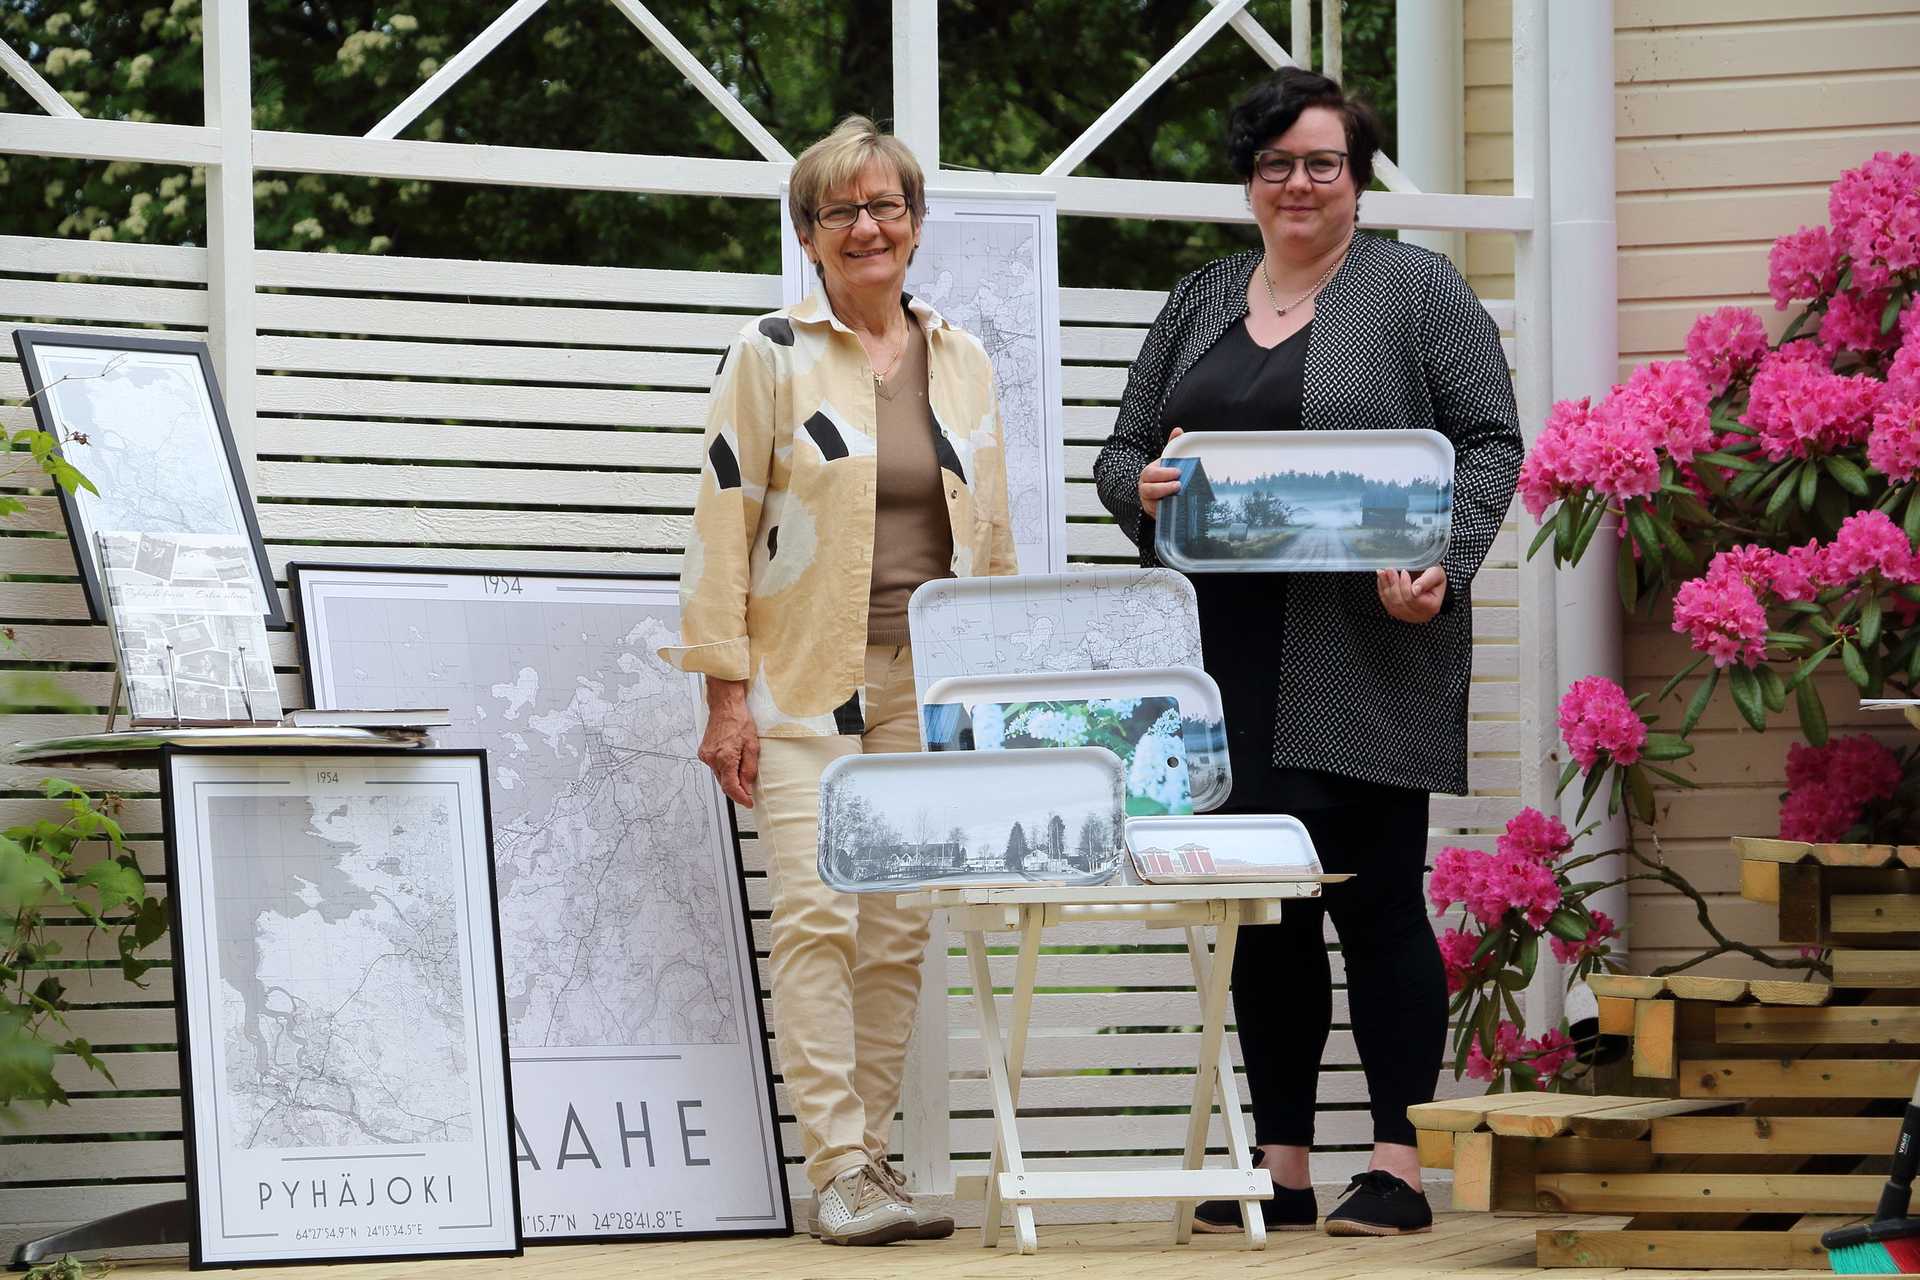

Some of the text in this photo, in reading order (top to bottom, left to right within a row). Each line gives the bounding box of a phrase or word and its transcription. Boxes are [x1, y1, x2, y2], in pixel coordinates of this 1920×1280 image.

[483, 576, 524, 595] 1954
[316, 771, 339, 784] 1954
[513, 1100, 711, 1171] AAHE
[258, 1172, 453, 1210] PYHÄJOKI
